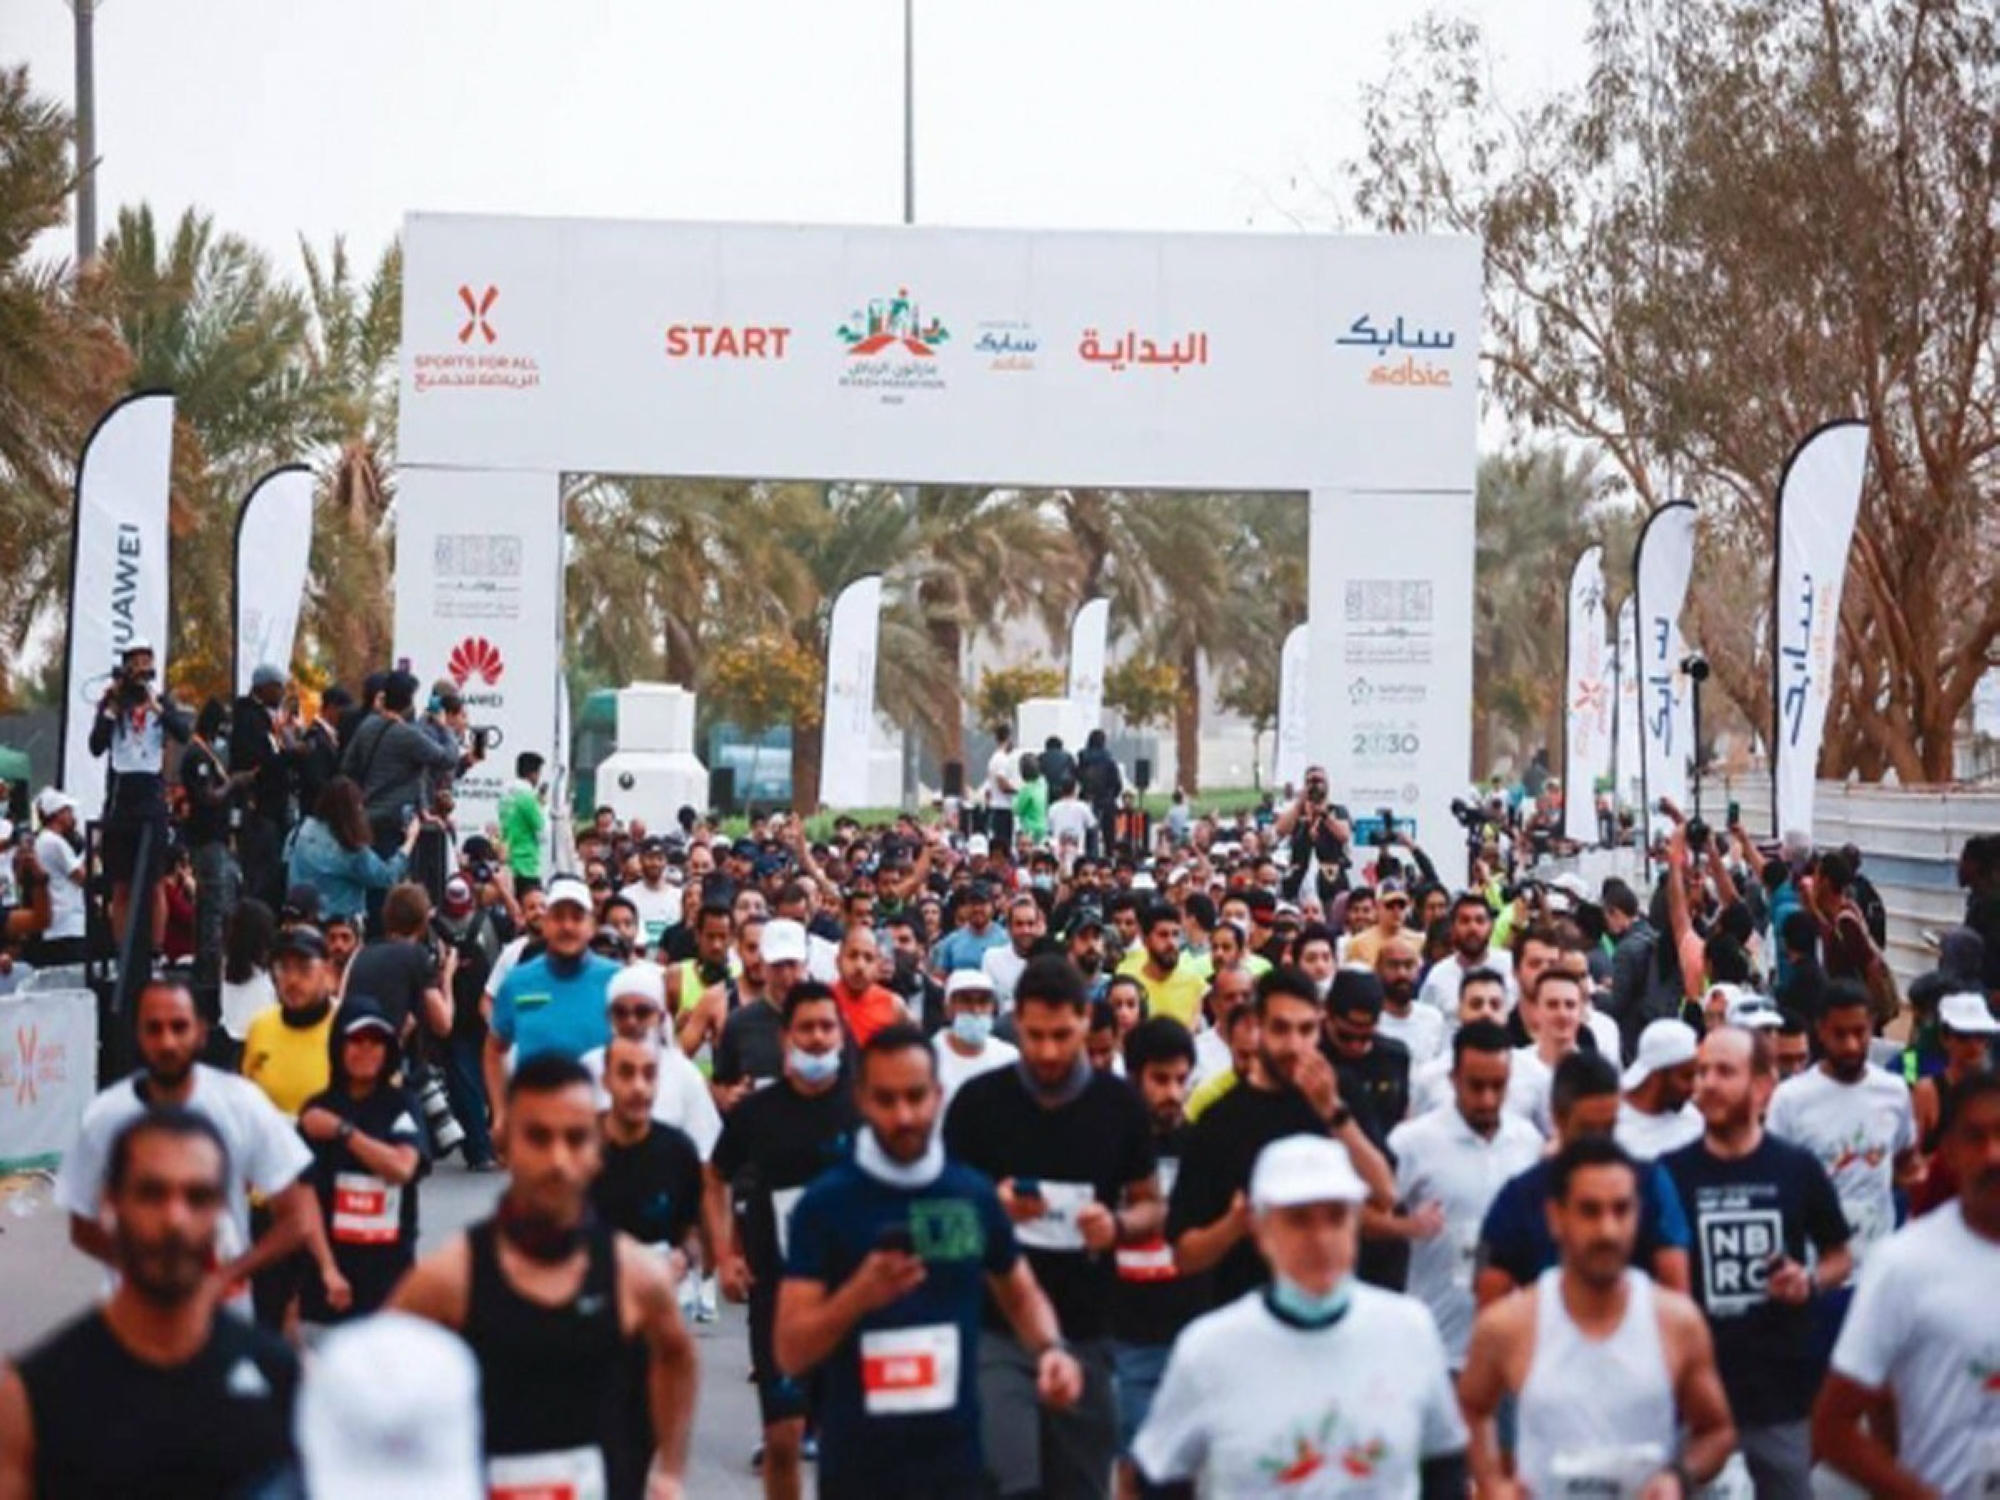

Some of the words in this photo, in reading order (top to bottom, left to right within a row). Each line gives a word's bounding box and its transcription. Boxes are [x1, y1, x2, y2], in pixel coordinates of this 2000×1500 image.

[666, 325, 791, 358] START
[1078, 327, 1208, 371] البداية
[1335, 314, 1456, 356] سابك
[414, 355, 476, 370] SPORTS
[479, 355, 508, 370] FOR
[512, 356, 539, 371] ALL
[1649, 616, 1679, 758] سابك
[1713, 1225, 1770, 1256] NB
